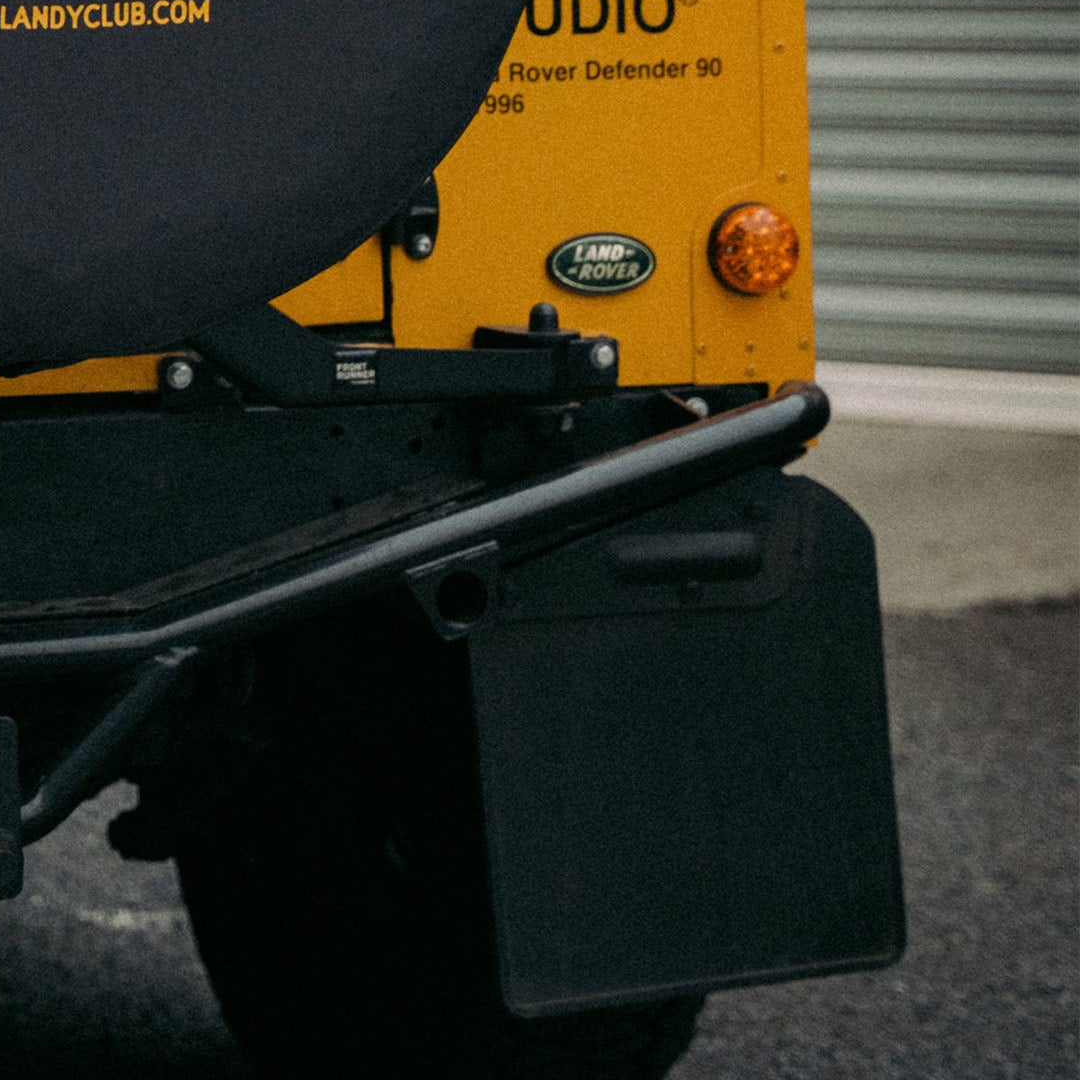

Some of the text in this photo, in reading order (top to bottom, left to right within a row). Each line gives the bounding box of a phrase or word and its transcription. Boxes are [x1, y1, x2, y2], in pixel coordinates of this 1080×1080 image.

[509, 63, 577, 82] Rover
[585, 58, 688, 81] Defender
[696, 57, 722, 77] 90
